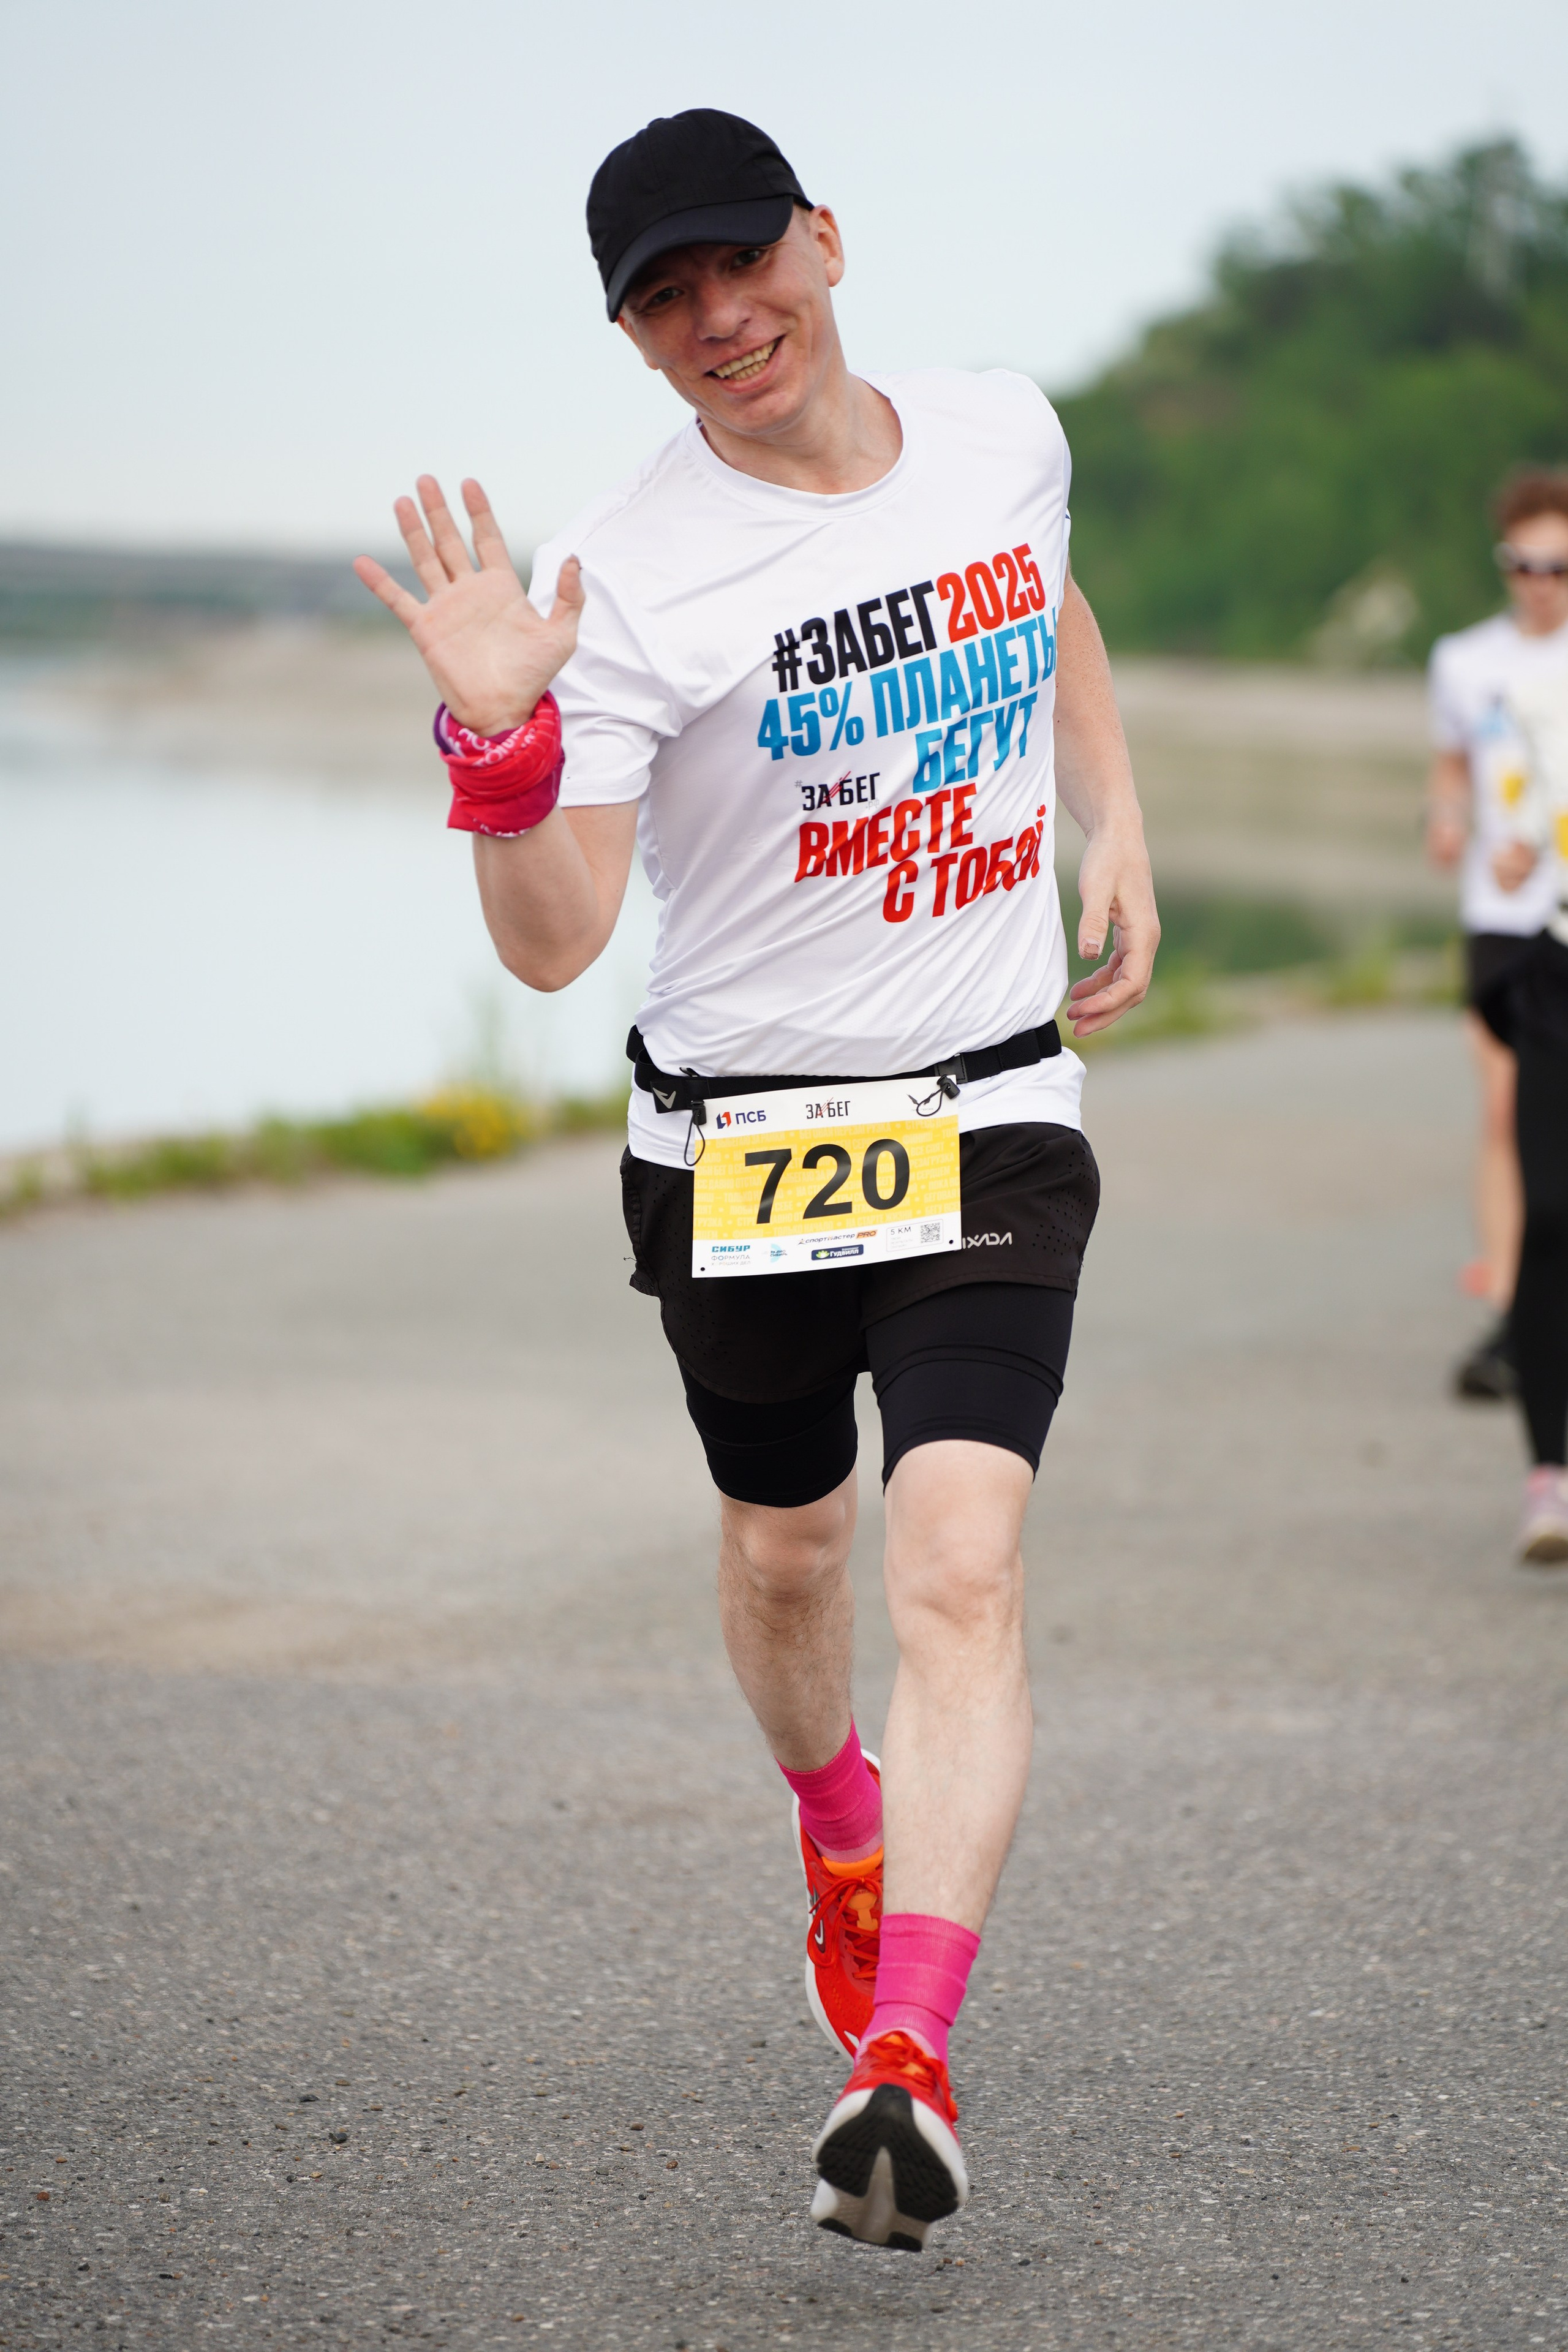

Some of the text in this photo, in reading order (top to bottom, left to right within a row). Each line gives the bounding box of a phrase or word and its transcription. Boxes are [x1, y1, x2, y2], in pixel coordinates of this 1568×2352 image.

[757, 681, 864, 761] 45%
[913, 691, 1038, 794] БЕГУТ
[794, 783, 977, 883] ВМЕСТЕ
[883, 804, 1046, 923] С ТОБОЙ
[735, 1110, 766, 1125] ПСБ
[745, 1139, 910, 1224] 720
[830, 1248, 859, 1257] Гудвилл
